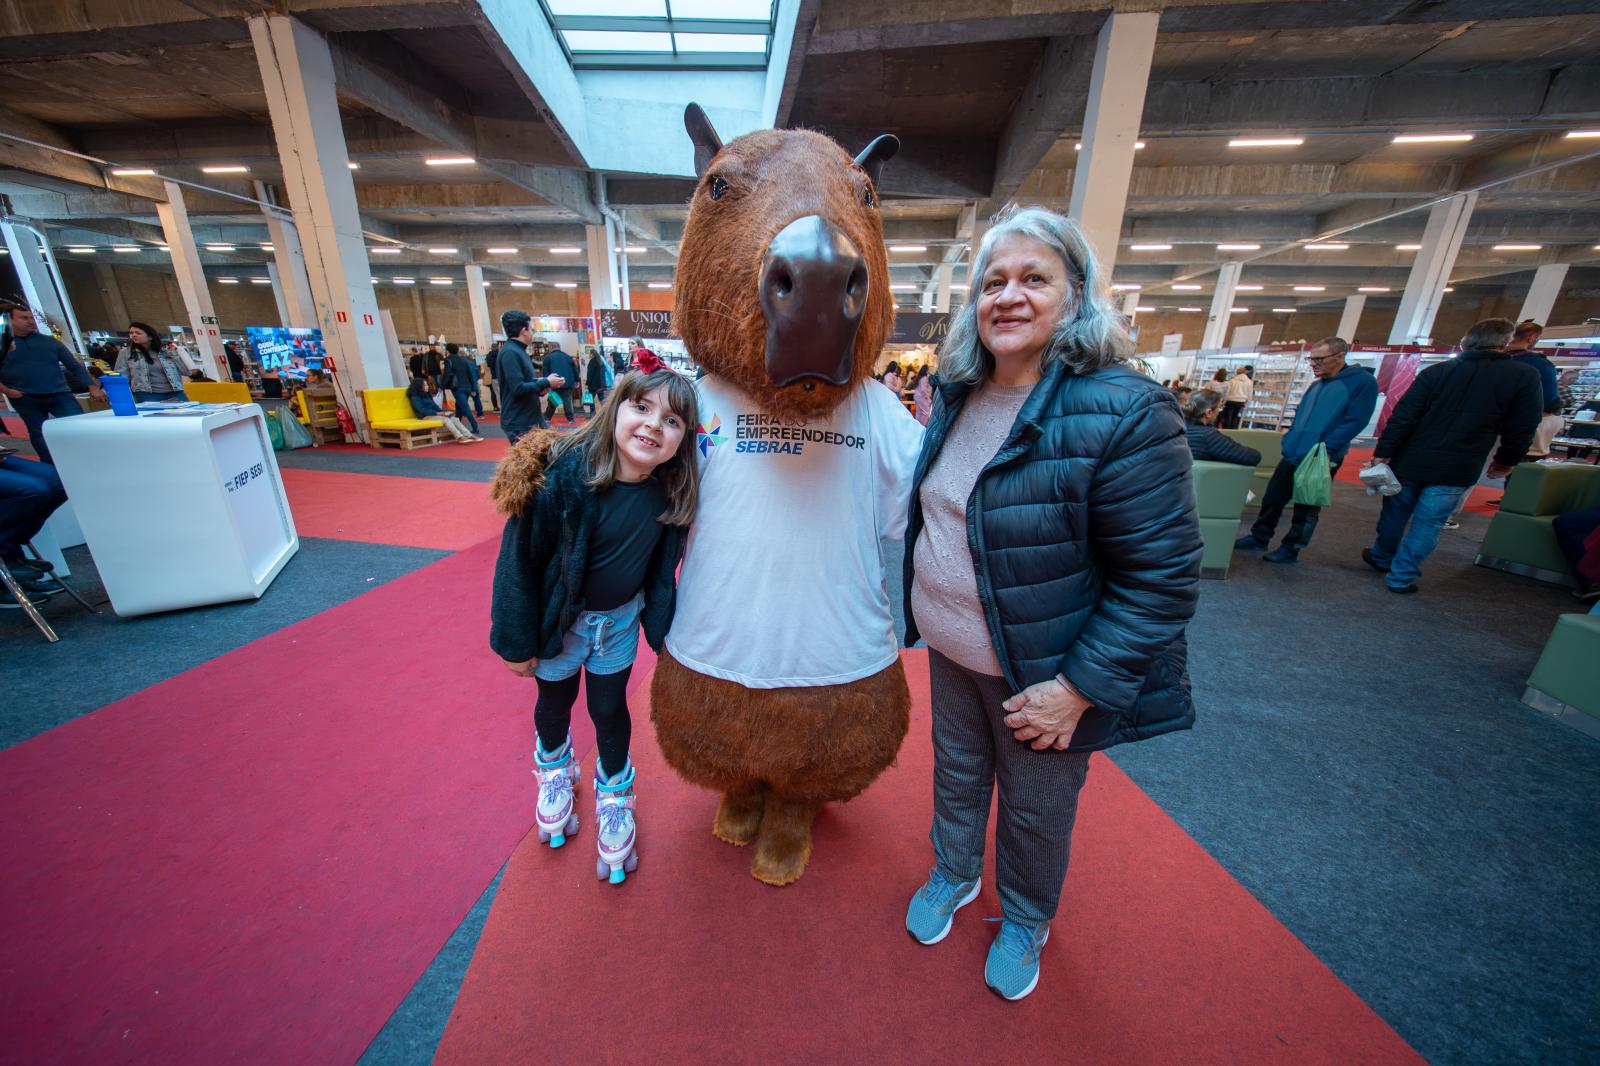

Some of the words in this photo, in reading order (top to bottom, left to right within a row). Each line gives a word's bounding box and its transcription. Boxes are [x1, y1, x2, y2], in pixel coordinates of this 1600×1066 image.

[261, 350, 291, 370] FAZ
[736, 413, 782, 426] FEIRA
[735, 441, 804, 455] SEBRAE
[736, 427, 867, 450] EMPREENDEDOR
[234, 471, 248, 489] FIEP
[250, 462, 264, 479] SESI
